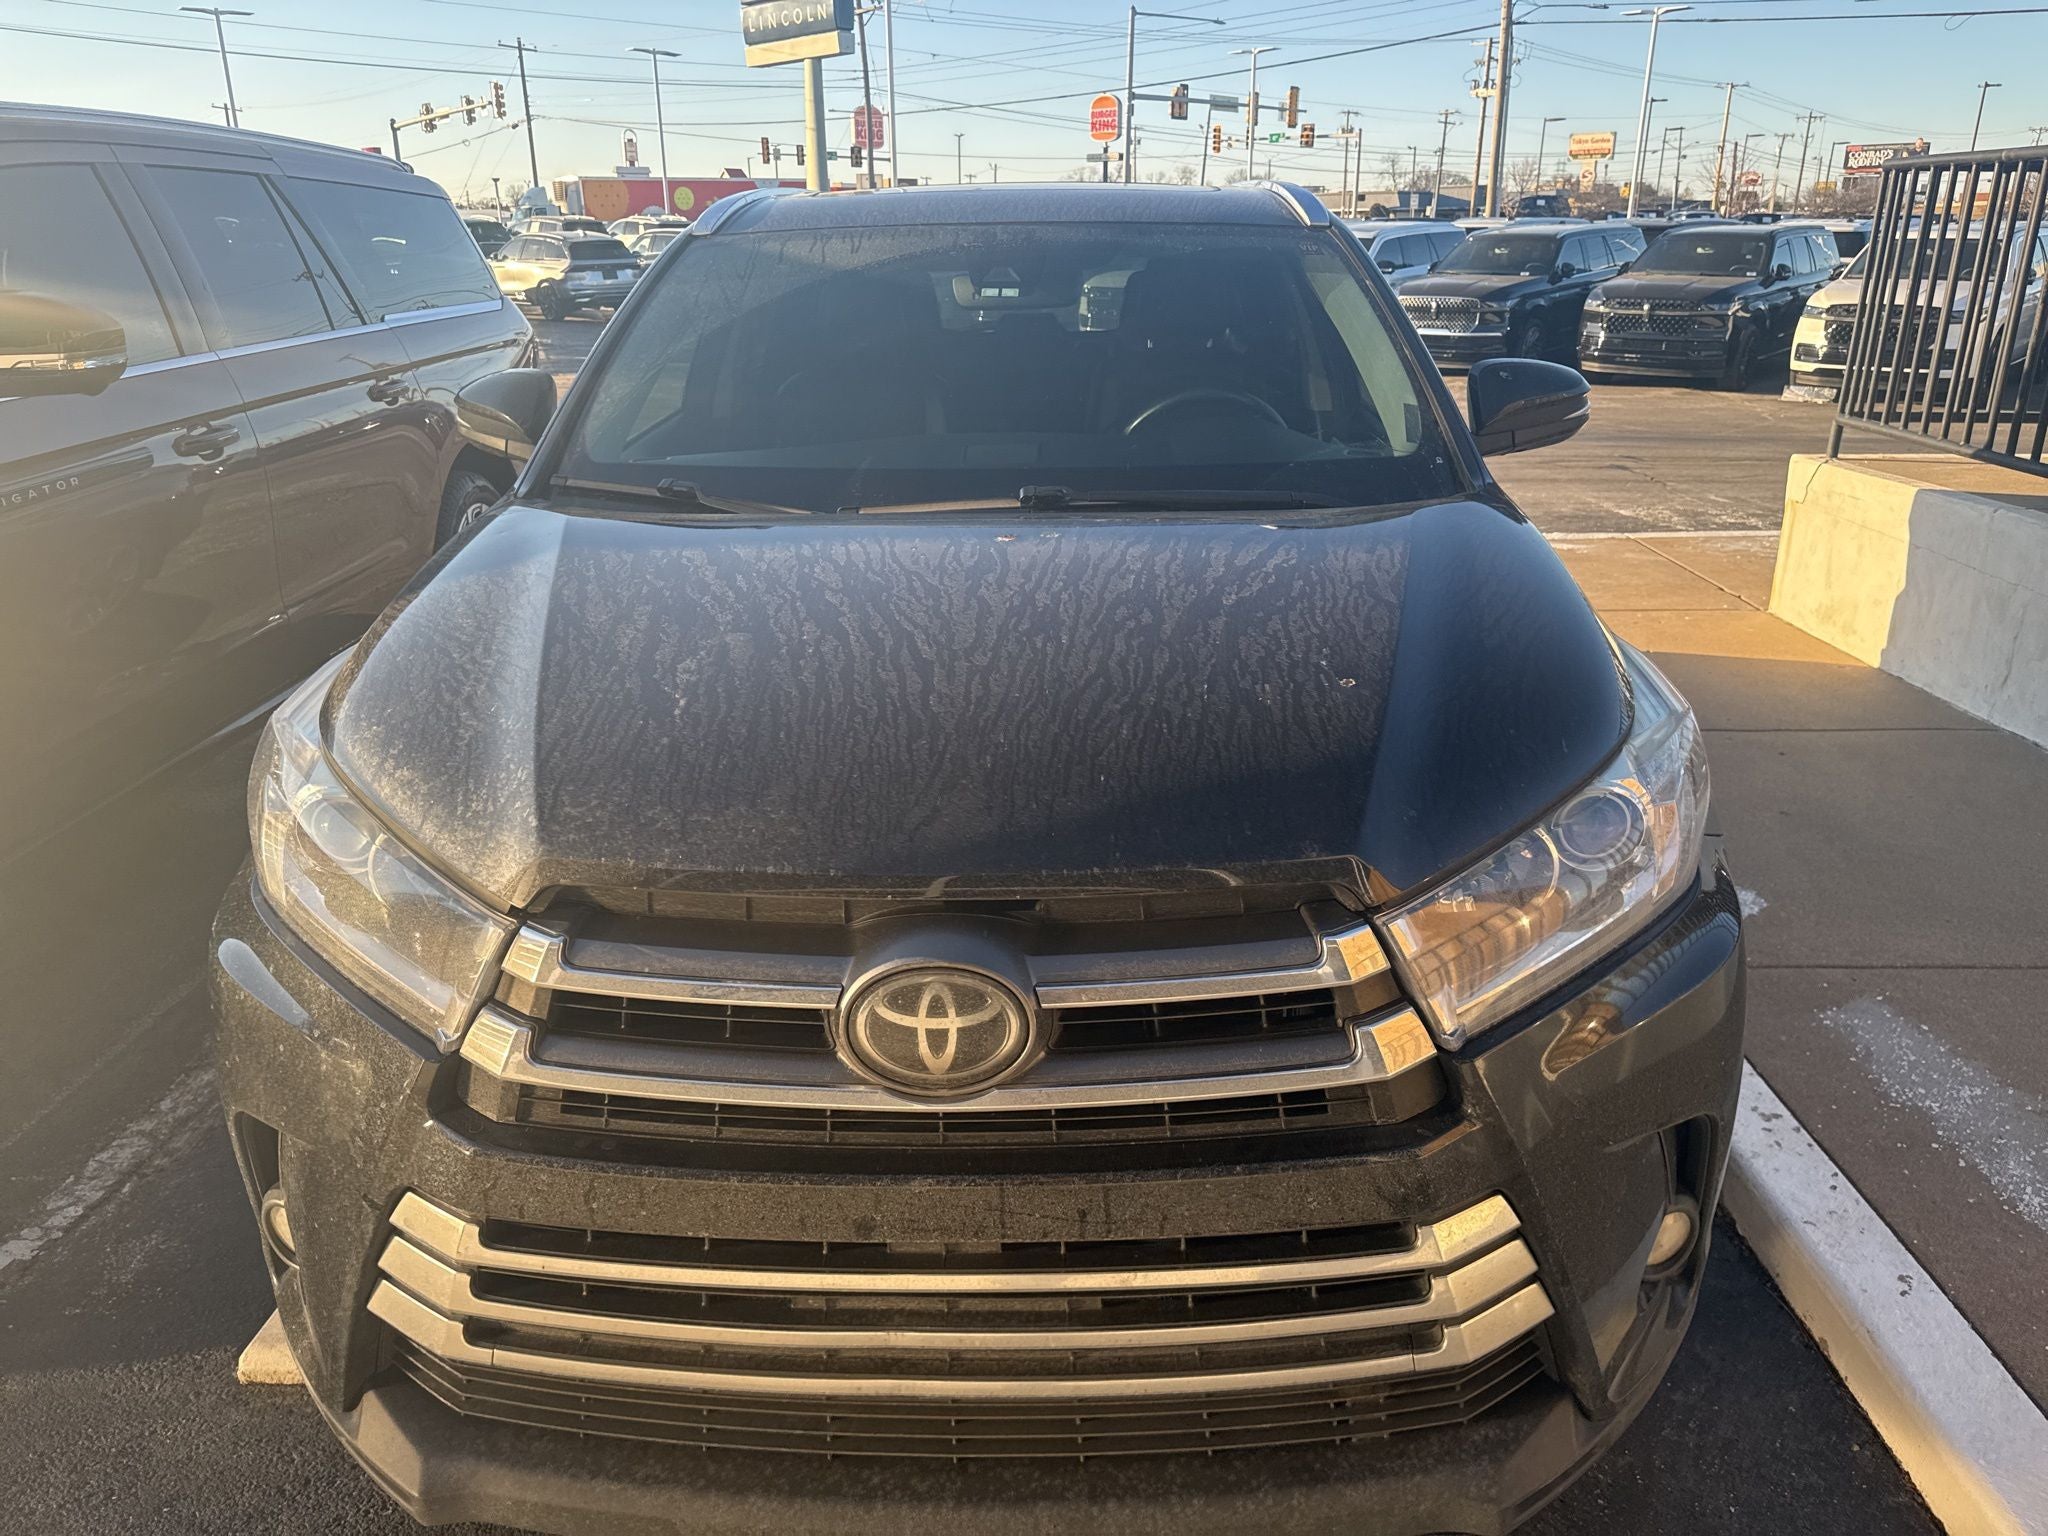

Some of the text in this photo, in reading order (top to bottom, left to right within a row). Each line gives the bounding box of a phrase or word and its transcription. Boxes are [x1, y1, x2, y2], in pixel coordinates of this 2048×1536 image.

[748, 4, 827, 32] LINCOLN
[1090, 109, 1117, 119] BURGER
[855, 119, 883, 128] BUER
[1090, 119, 1117, 132] KING
[856, 128, 883, 140] KIG
[1848, 149, 1894, 159] CONRAD'S
[1847, 157, 1884, 168] ROOFIN
[0, 477, 79, 506] IGATOR
